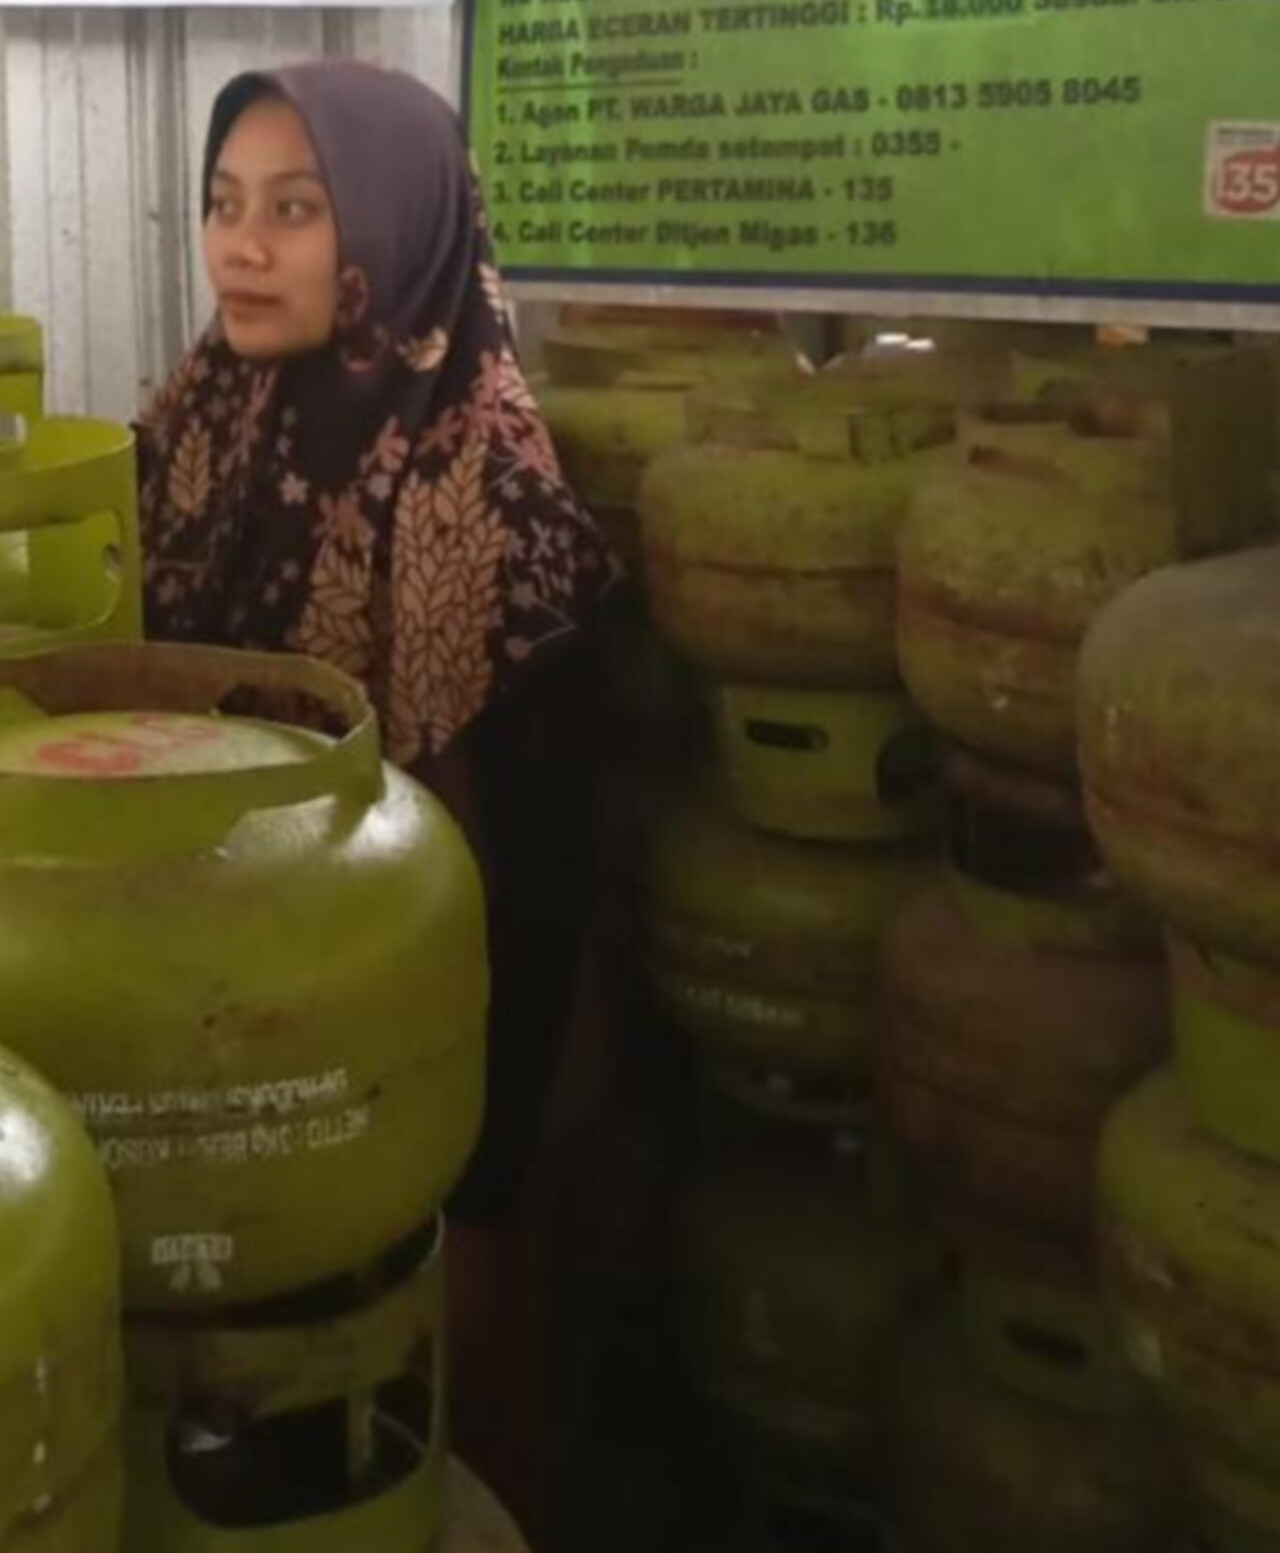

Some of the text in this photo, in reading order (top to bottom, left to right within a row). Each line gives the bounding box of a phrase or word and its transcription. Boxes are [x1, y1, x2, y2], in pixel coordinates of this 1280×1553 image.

[499, 18, 580, 46] HARGA
[588, 11, 691, 41] ECERAN
[698, 1, 850, 33] TERTINGGI
[521, 102, 580, 129] Agen
[630, 92, 726, 121] WARGA
[734, 90, 803, 117] JAYA
[811, 87, 871, 114] GAS
[895, 83, 967, 111] 0813
[1063, 75, 1142, 105] 8045
[495, 141, 514, 165] 2.
[521, 139, 618, 169] Layanan
[624, 136, 710, 162] Pemda
[718, 133, 845, 162] setempat
[871, 131, 942, 157] 0355
[520, 178, 564, 203] Call
[571, 178, 651, 203] Center
[657, 176, 816, 202] PERTAMINA
[843, 176, 895, 202] 135
[520, 219, 564, 244] Call
[570, 219, 649, 244] Center
[656, 218, 731, 251] Ditjen
[738, 219, 818, 252] Migas
[846, 219, 897, 246] 136
